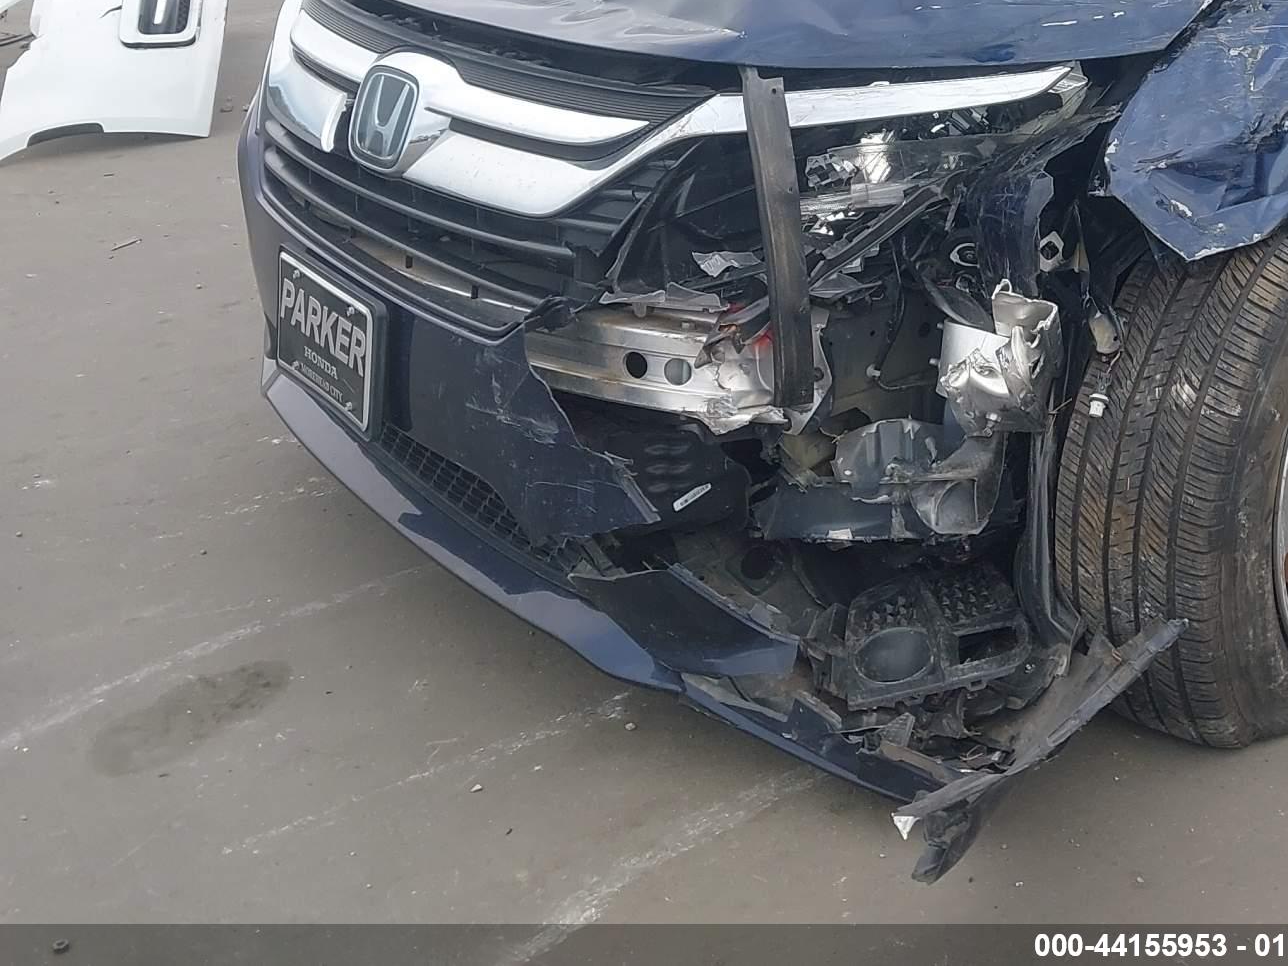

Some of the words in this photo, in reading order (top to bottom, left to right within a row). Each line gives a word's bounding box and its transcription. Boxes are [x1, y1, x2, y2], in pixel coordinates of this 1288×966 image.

[280, 278, 366, 377] PARKER
[303, 345, 338, 380] HONDA
[330, 386, 343, 402] CITY
